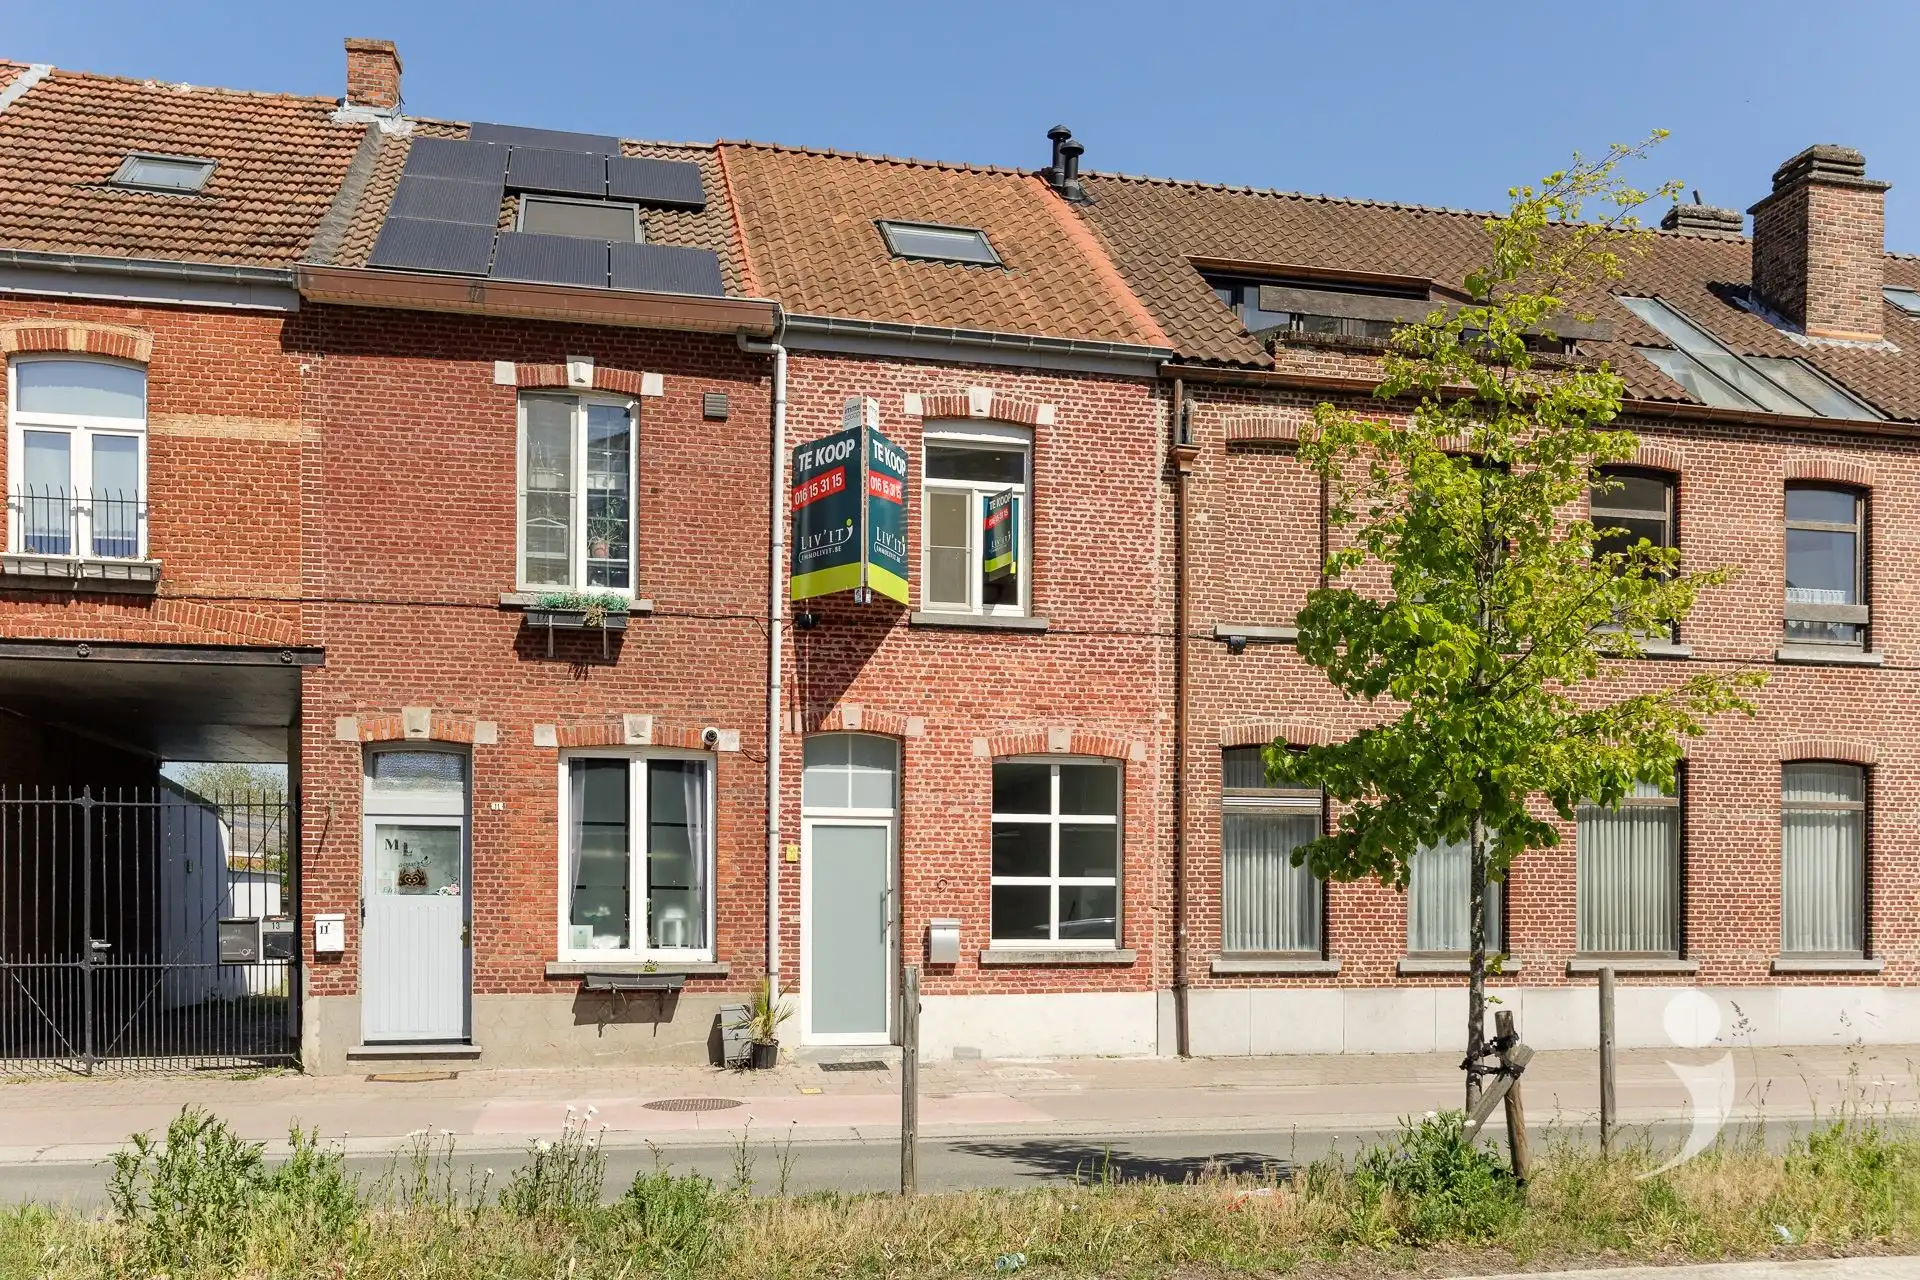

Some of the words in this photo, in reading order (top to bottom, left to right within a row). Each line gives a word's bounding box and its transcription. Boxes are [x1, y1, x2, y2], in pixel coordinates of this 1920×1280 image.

[799, 450, 813, 472] TE
[815, 438, 856, 467] KOOP
[872, 439, 884, 463] TE
[884, 446, 906, 477] KOOP
[794, 487, 808, 505] 016
[809, 482, 819, 498] 15
[820, 477, 830, 493] 31
[832, 472, 843, 488] 15
[870, 475, 882, 492] 016
[989, 500, 996, 511] TE
[996, 493, 1012, 508] KOOP
[272, 921, 280, 930] 13
